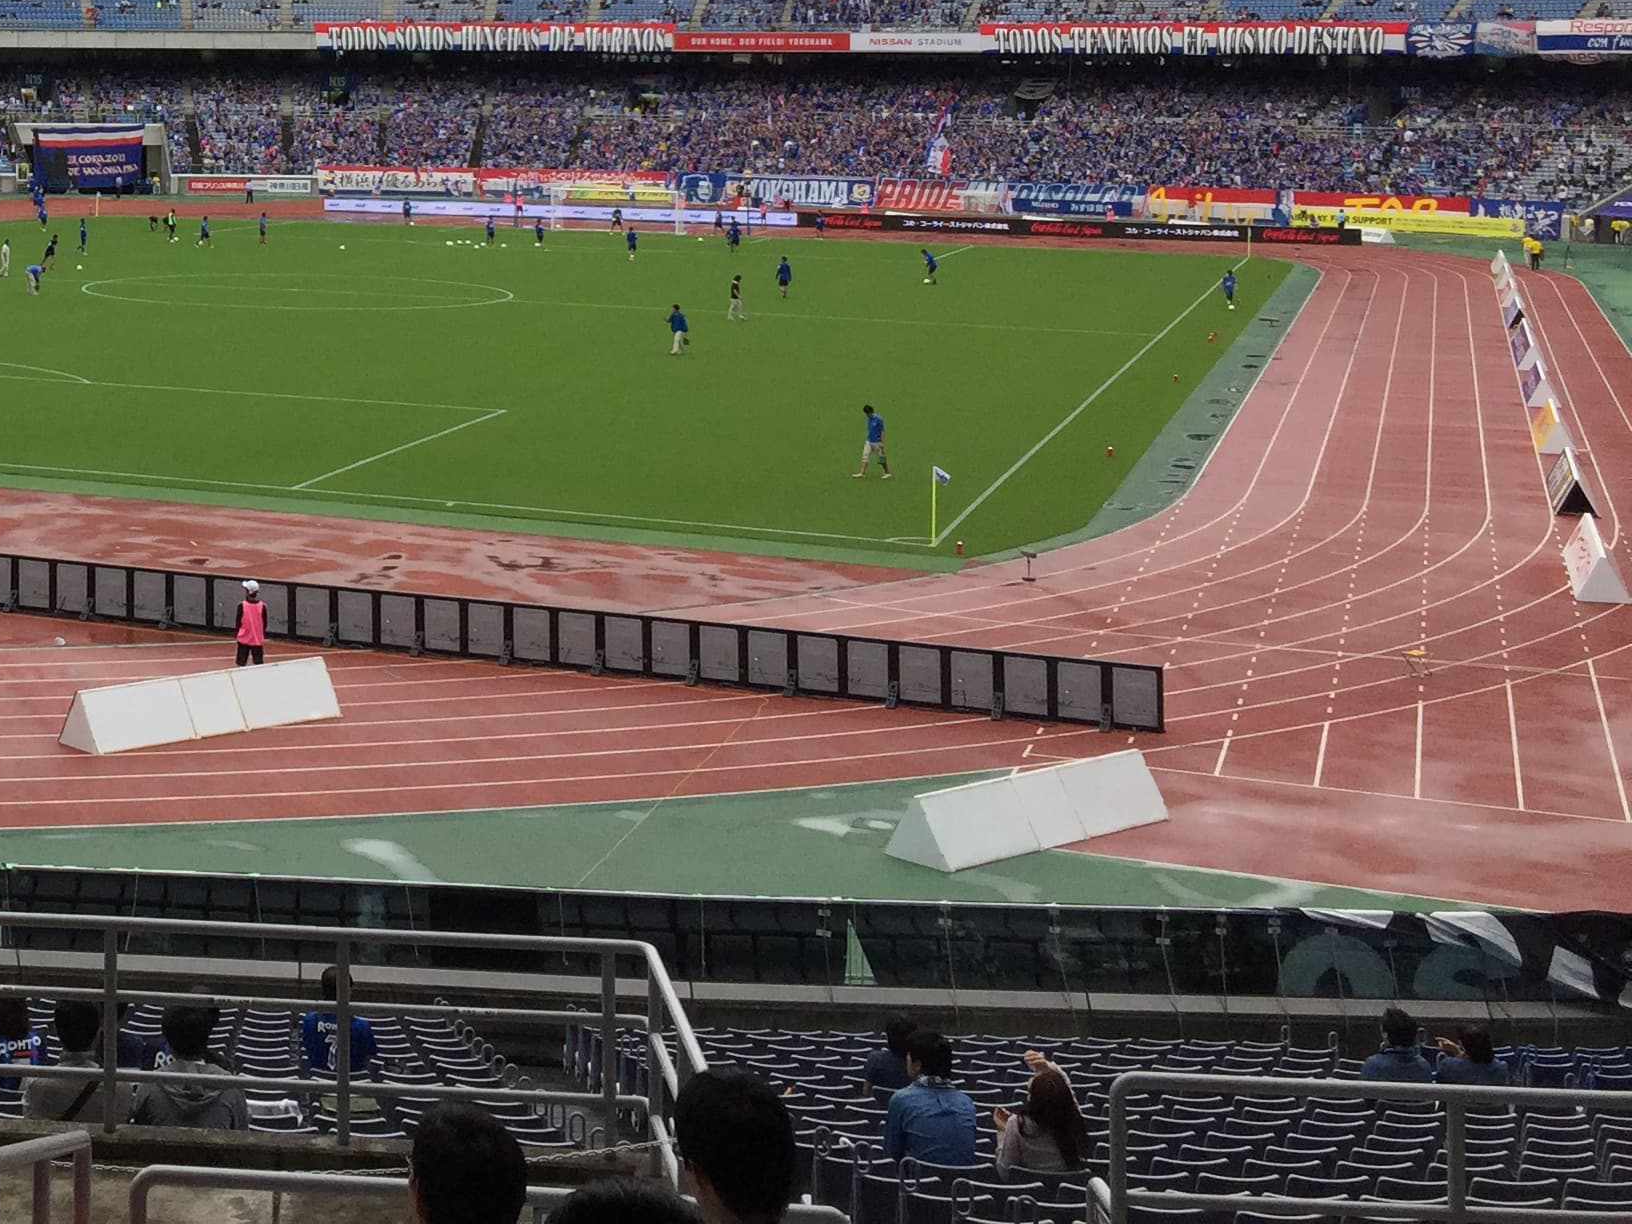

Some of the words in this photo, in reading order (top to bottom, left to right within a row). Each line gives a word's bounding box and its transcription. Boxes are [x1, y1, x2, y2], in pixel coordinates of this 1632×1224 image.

[327, 25, 387, 52] TODOS
[394, 26, 454, 52] SOMOS
[461, 25, 541, 52] HINCHAS
[548, 26, 576, 52] DE
[583, 26, 666, 53] MARINOS
[788, 37, 833, 46] YOKOHAMA
[869, 38, 913, 46] NISSAN
[918, 37, 962, 47] STADIUM
[994, 26, 1063, 54] TODOS
[1070, 26, 1173, 55] TENEMOS
[1182, 27, 1209, 55] EL
[1217, 26, 1288, 55] MISMO
[1294, 25, 1385, 55] DESTINO
[749, 178, 849, 206] YOKOHAMA
[876, 177, 967, 211] PRIDE
[1070, 202, 1112, 214] みずほ銀
[1352, 215, 1393, 226] SUPPORT
[317, 1020, 338, 1033] ROH
